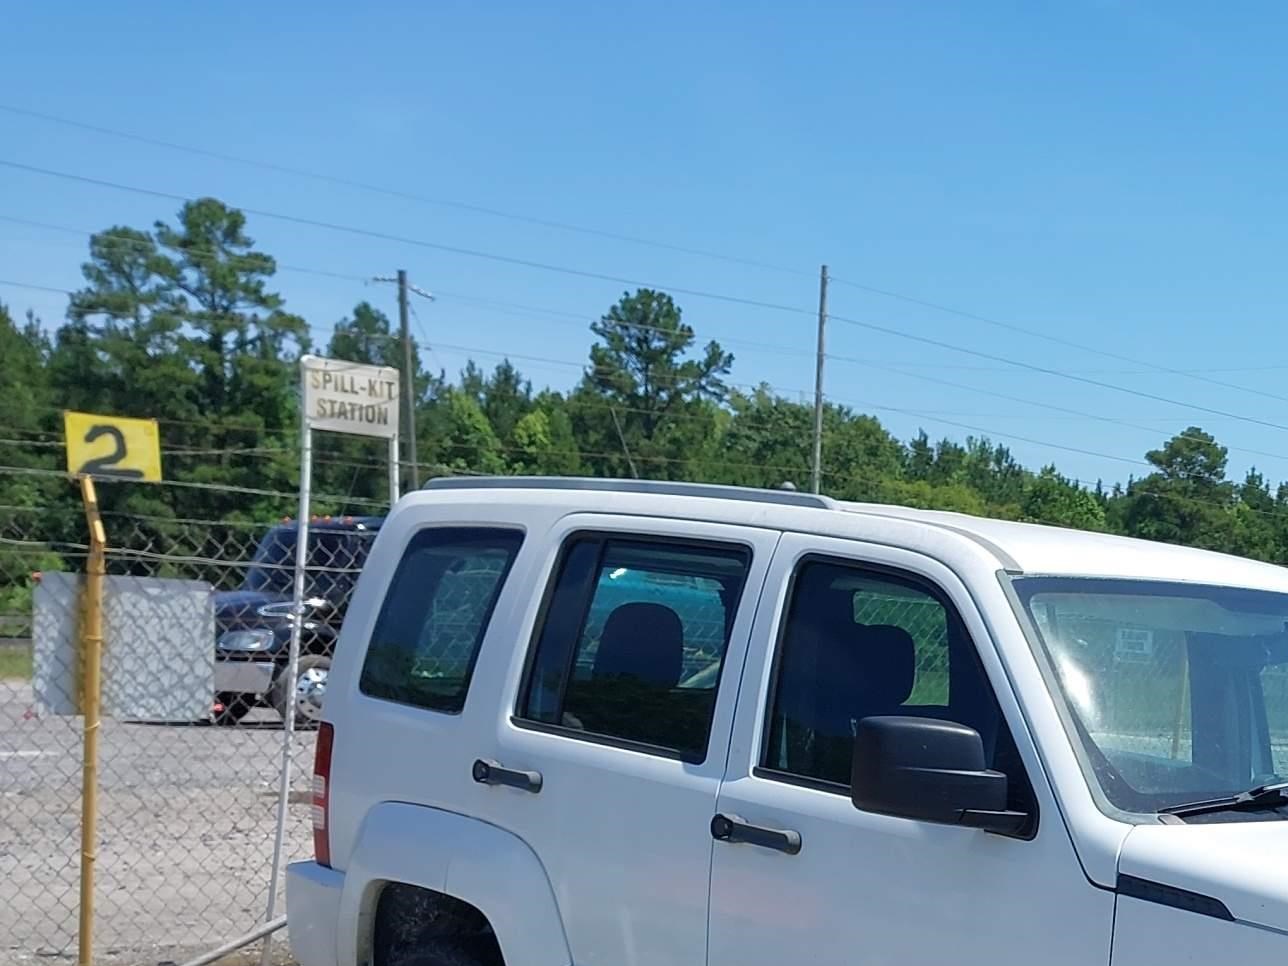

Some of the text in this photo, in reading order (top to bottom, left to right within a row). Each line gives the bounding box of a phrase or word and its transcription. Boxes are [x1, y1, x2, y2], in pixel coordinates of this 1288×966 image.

[311, 368, 395, 400] SPILL-KIT
[317, 398, 388, 425] STATION
[78, 425, 144, 479] 2
